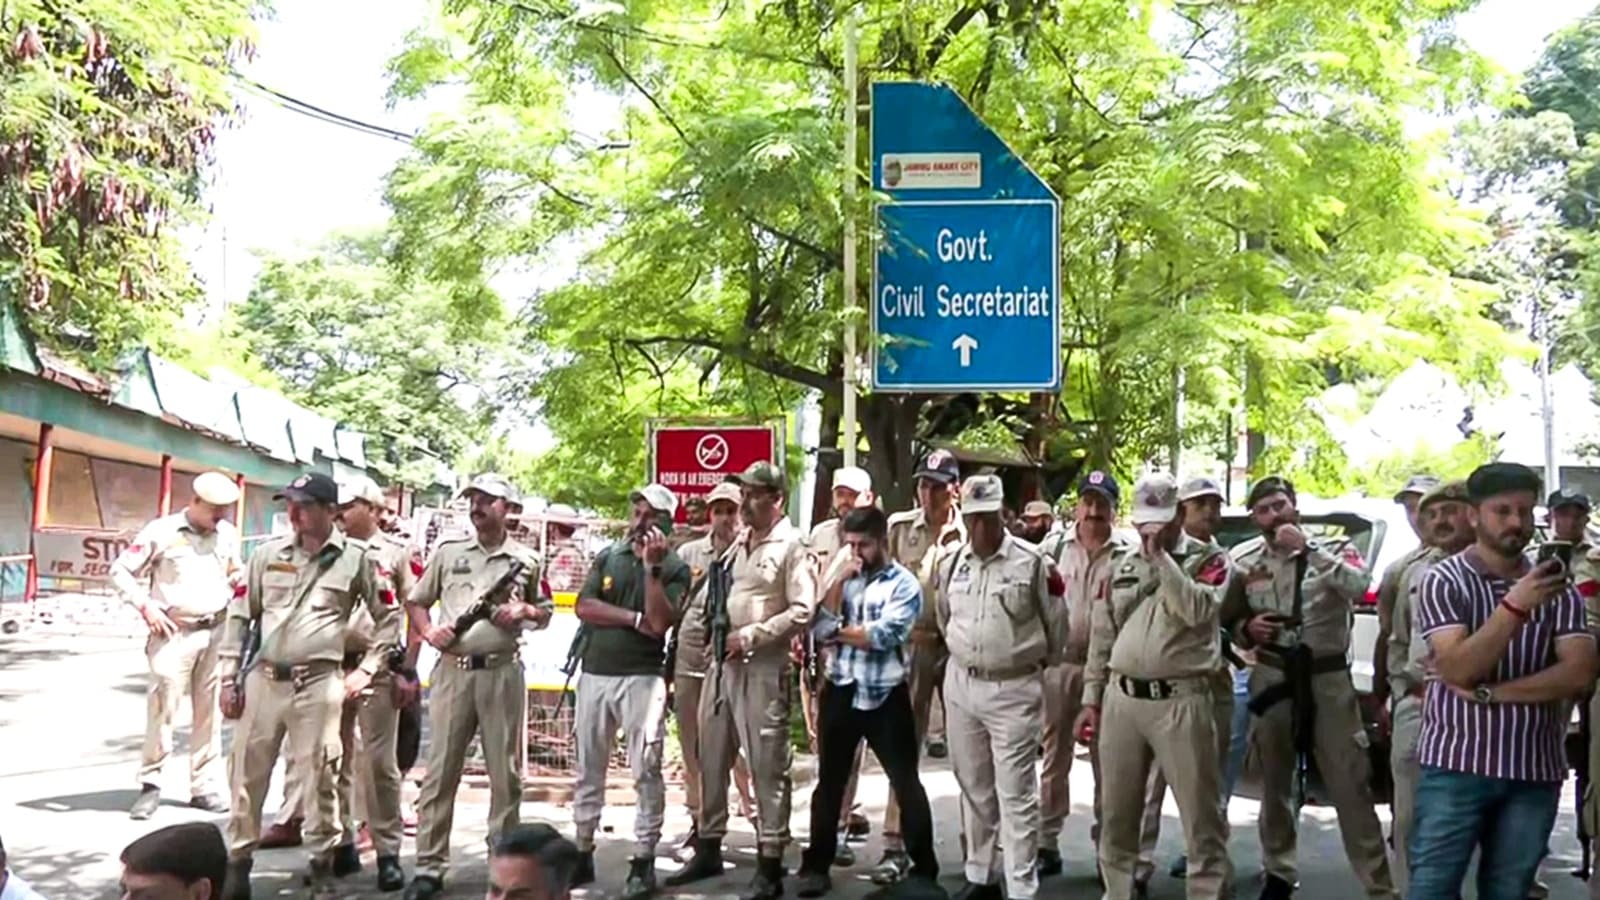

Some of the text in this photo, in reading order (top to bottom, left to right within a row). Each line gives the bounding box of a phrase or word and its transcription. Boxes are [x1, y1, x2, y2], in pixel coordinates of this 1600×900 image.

[937, 228, 993, 261] Govt.
[881, 284, 1049, 317] Civil Secretariat
[83, 536, 133, 562] STO
